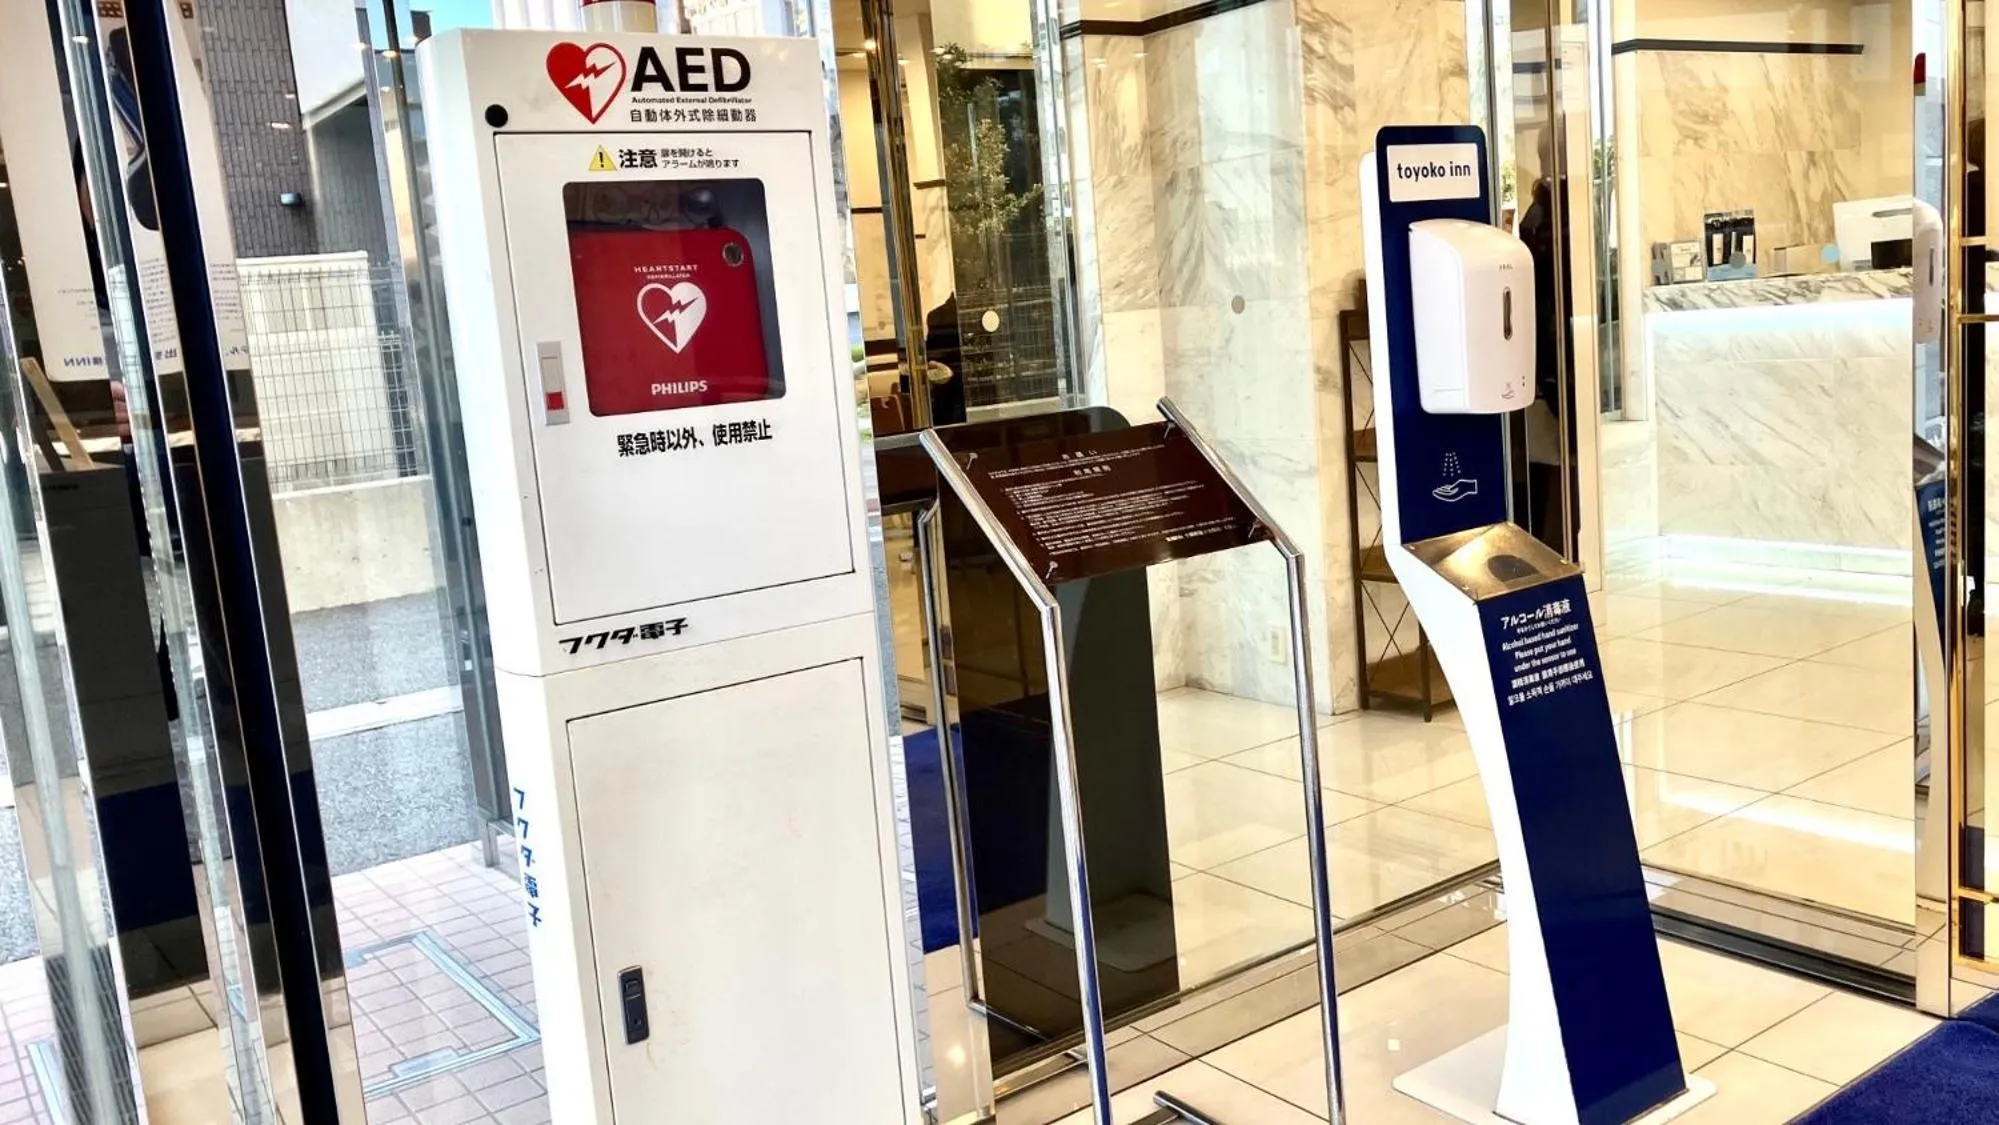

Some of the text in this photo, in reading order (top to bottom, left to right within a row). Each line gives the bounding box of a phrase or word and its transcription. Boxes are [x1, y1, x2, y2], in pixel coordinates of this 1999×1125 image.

[630, 46, 751, 92] AED
[630, 109, 757, 122] 自動体外式除細動器
[619, 149, 658, 169] 注意
[1397, 161, 1471, 182] toyoko inn
[633, 264, 699, 274] HEARTSTART
[651, 380, 708, 395] PHILIPS
[617, 419, 773, 457] 緊急時以外、使用禁止
[1501, 598, 1571, 630] アルコール消毒液
[559, 617, 689, 654] フクダ電子
[1541, 628, 1556, 639] hand
[1515, 636, 1572, 660] Please put your hand
[1514, 662, 1531, 672] under
[1531, 659, 1541, 667] the
